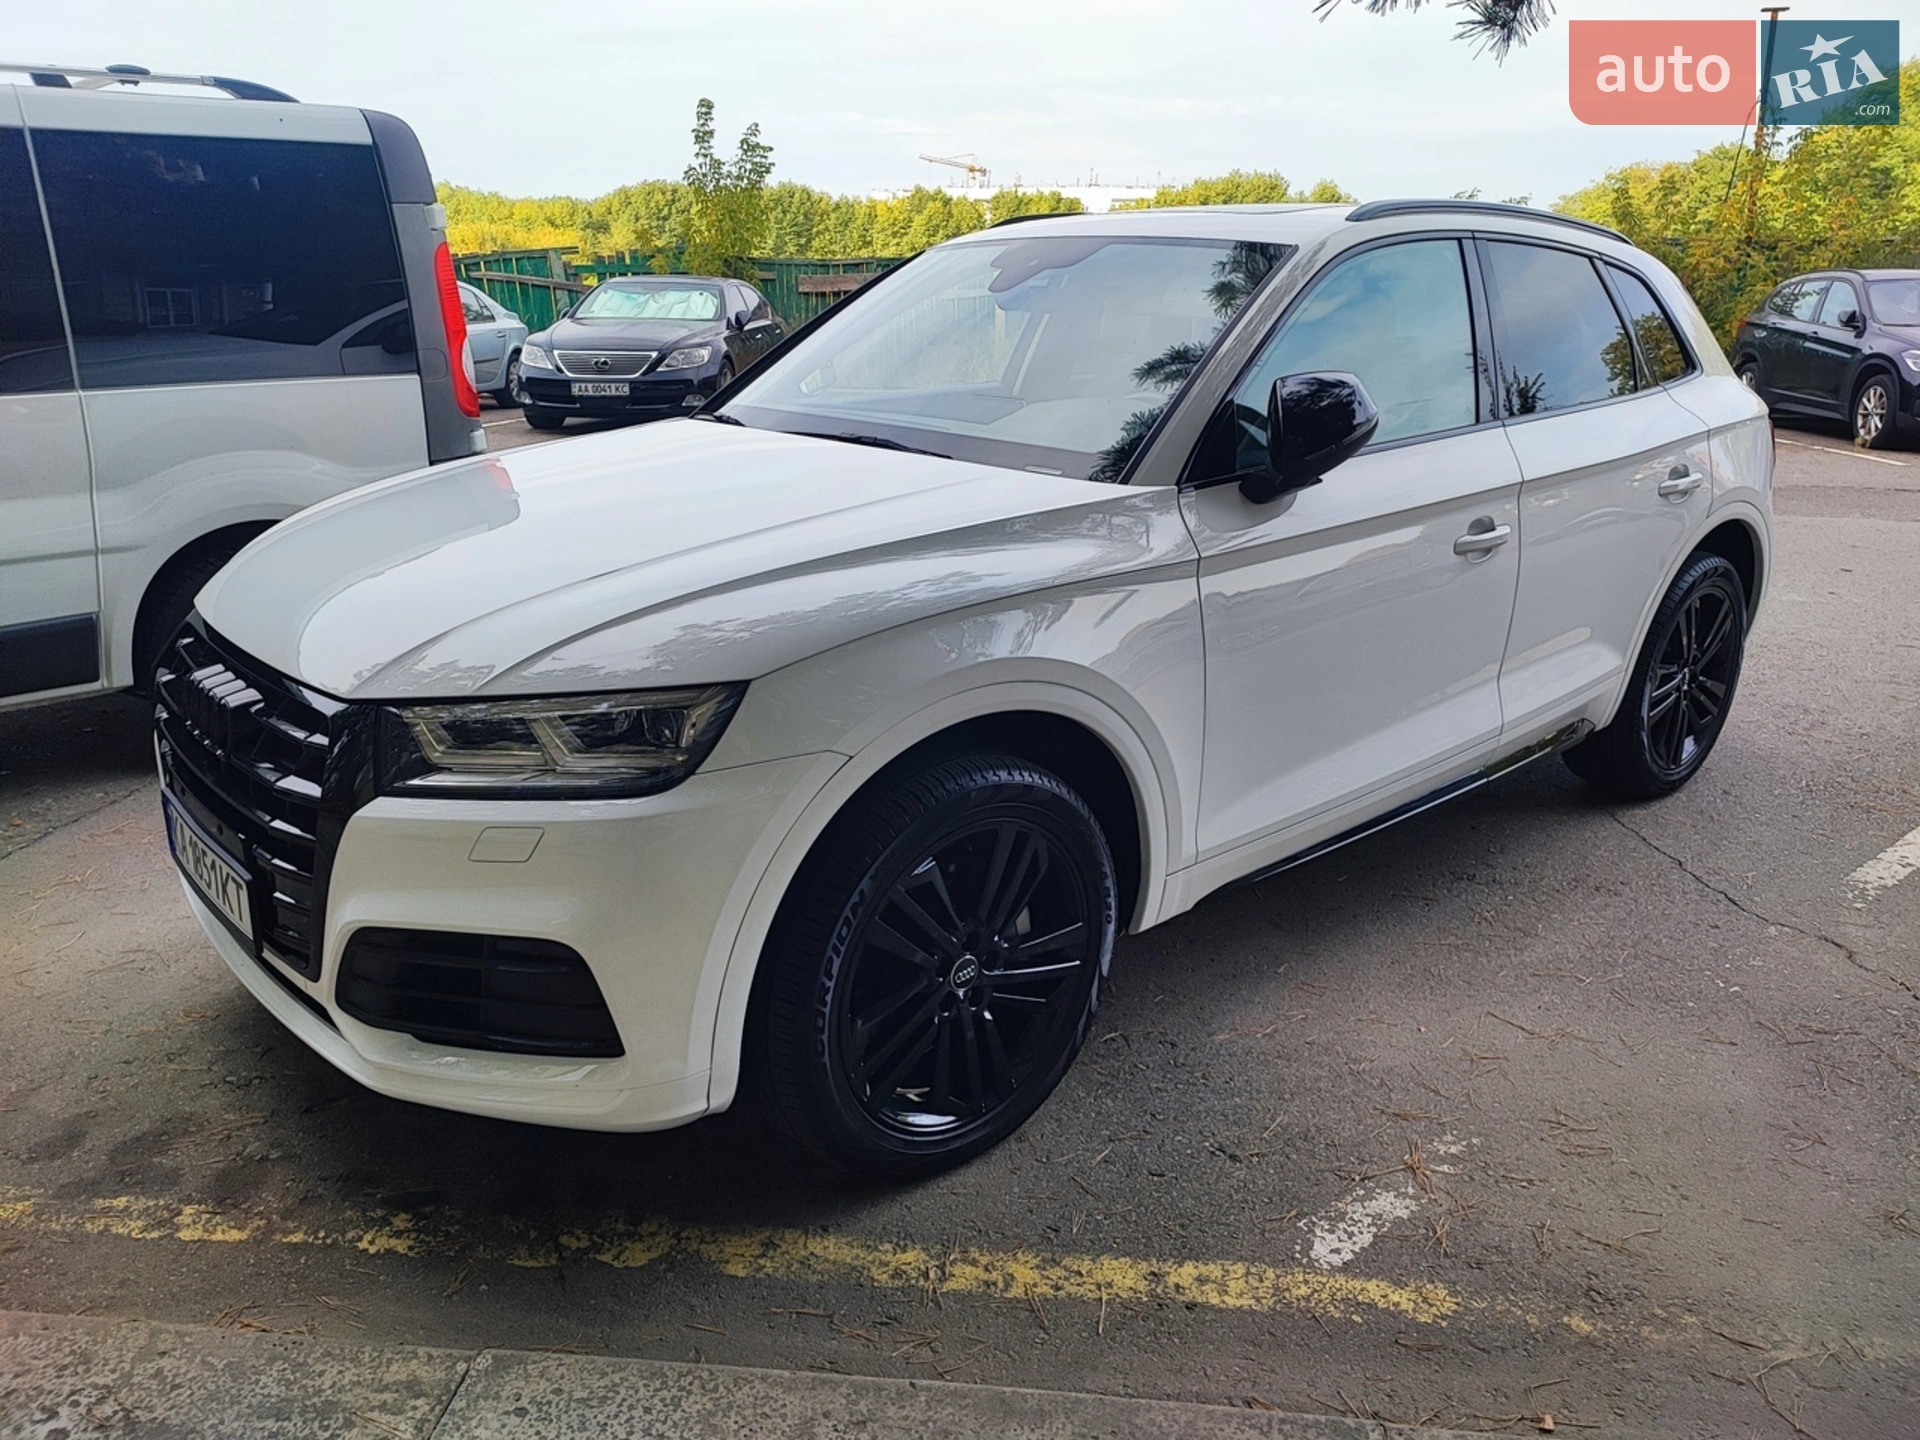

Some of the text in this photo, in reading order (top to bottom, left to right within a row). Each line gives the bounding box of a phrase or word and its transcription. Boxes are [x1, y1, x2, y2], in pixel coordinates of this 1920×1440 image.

[577, 384, 629, 394] AA 0041 KC
[219, 864, 244, 922] KT
